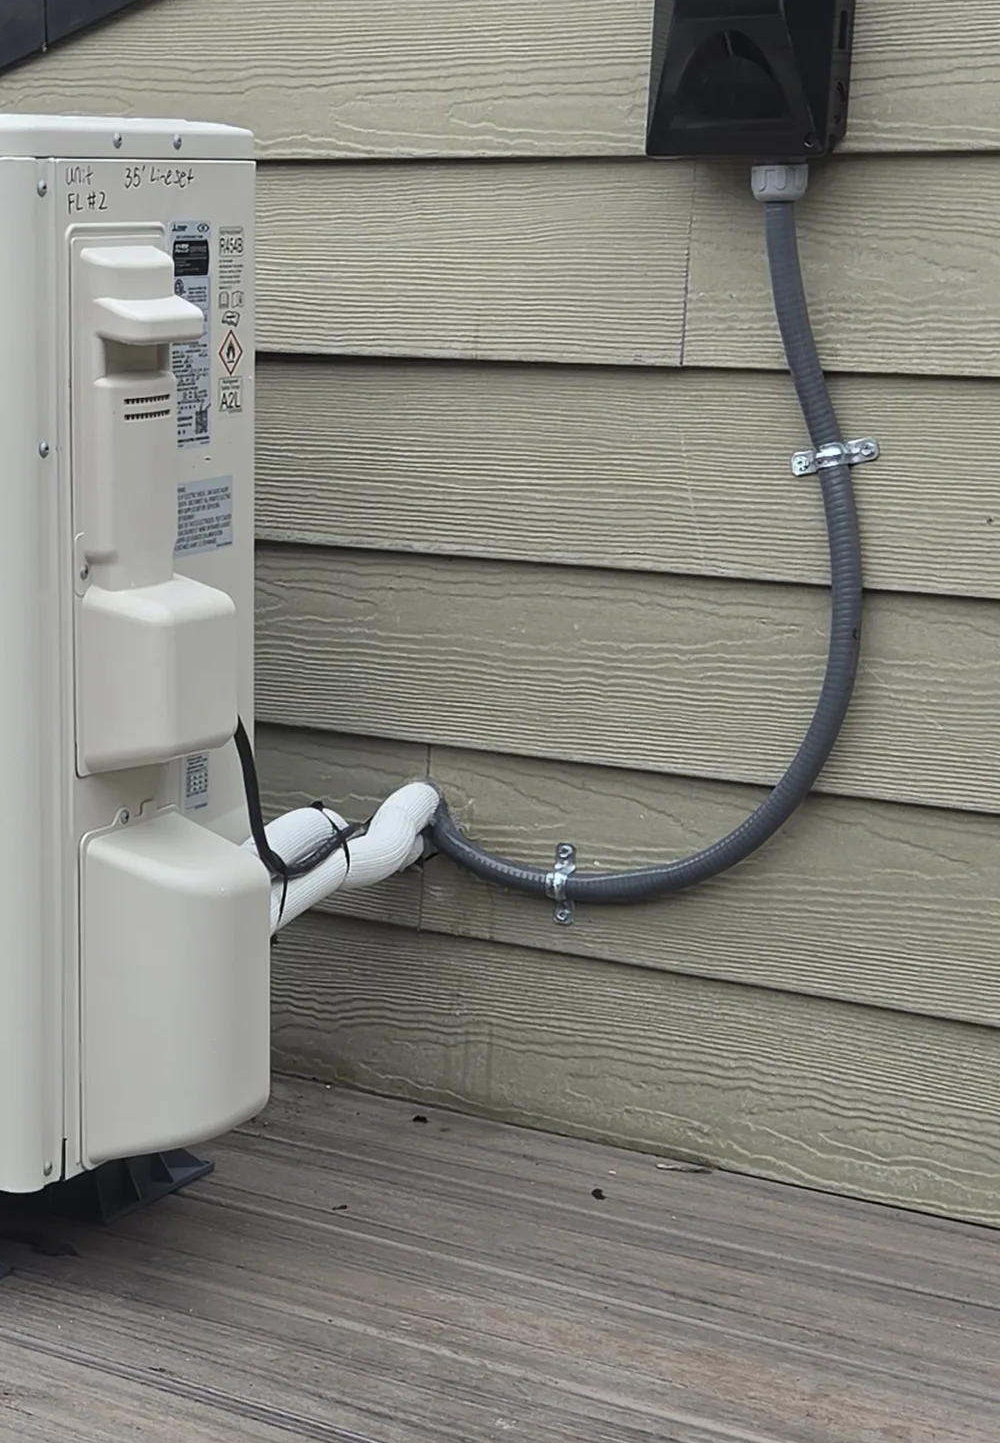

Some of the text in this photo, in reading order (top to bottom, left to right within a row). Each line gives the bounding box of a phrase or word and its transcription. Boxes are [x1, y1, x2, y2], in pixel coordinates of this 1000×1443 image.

[67, 191, 107, 215] FL #2
[220, 391, 242, 409] A2L
